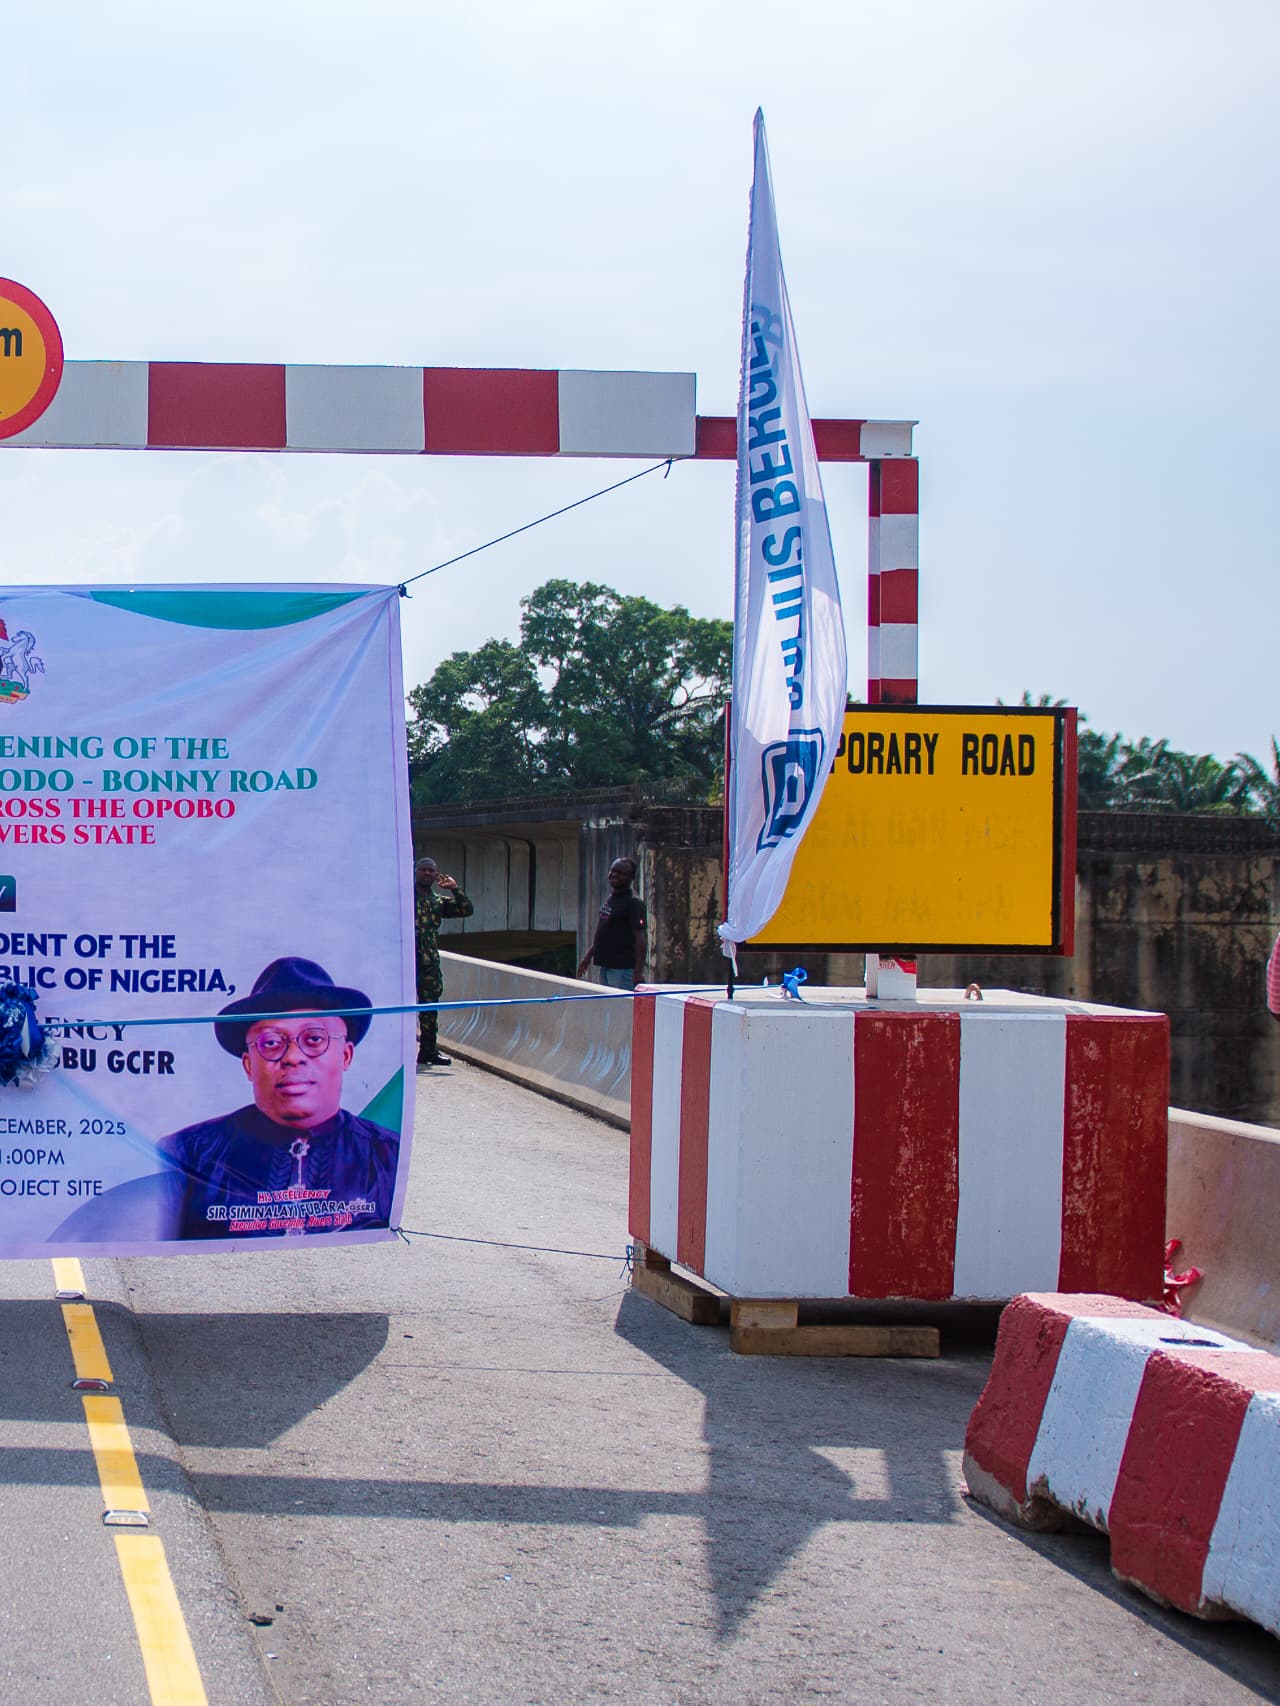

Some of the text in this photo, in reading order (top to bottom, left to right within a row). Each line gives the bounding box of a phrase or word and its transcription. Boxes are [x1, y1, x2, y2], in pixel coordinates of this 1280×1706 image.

[748, 321, 801, 524] BERGE
[113, 736, 156, 760] OF
[164, 737, 229, 760] THE
[830, 732, 1035, 776] PORARY ROAD
[102, 770, 220, 793] BONNY
[229, 768, 318, 793] ROAD
[67, 798, 126, 819] THE
[132, 798, 235, 819] OPOBO
[73, 824, 156, 845] STATE
[74, 934, 113, 958] OF
[119, 934, 176, 959] THE
[64, 967, 103, 991] OF
[110, 968, 236, 996] NIGERIA,
[107, 1050, 175, 1075] GCFR
[79, 1119, 126, 1135] 2025
[67, 1180, 103, 1196] SITE
[208, 1206, 226, 1219] SIR
